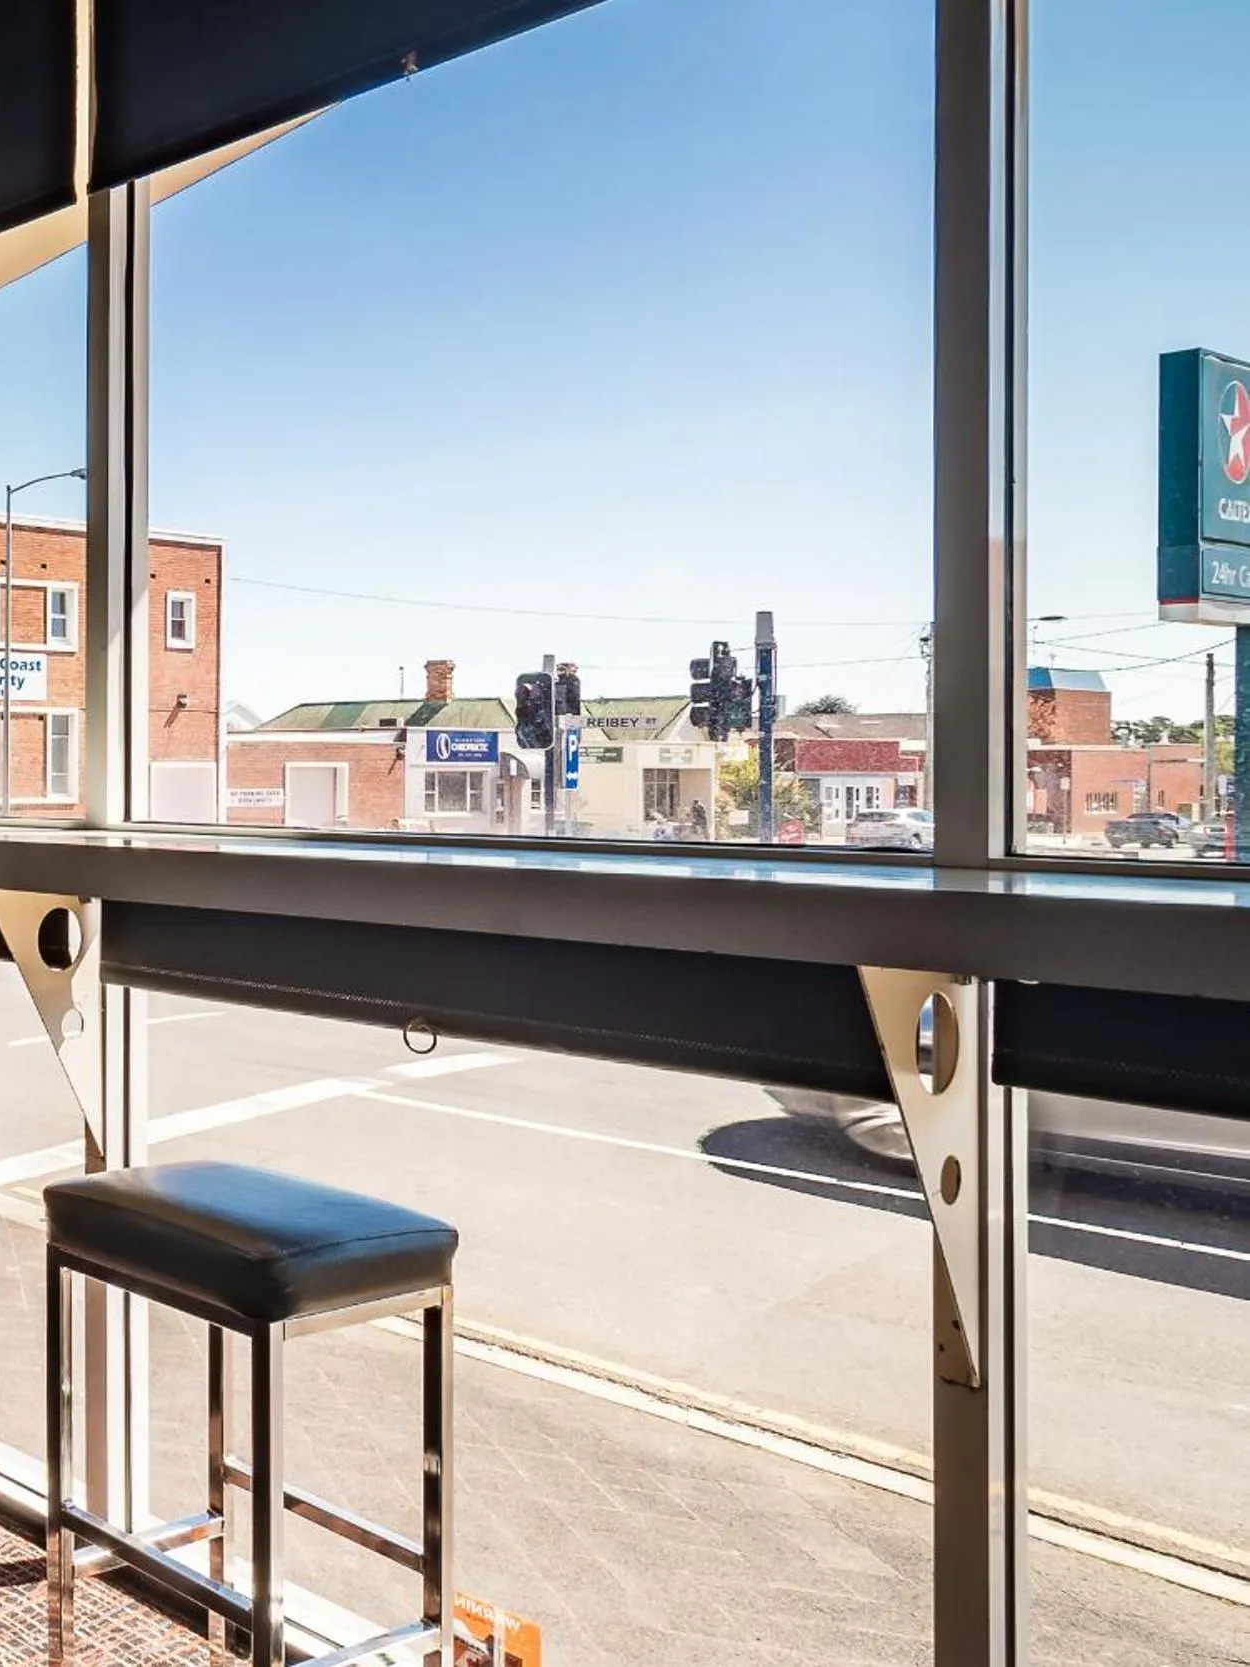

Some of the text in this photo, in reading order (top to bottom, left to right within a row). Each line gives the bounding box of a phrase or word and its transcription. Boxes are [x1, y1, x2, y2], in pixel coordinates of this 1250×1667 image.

[1219, 497, 1250, 524] CALTE
[0, 658, 42, 672] Coast
[587, 717, 640, 728] REIBEY
